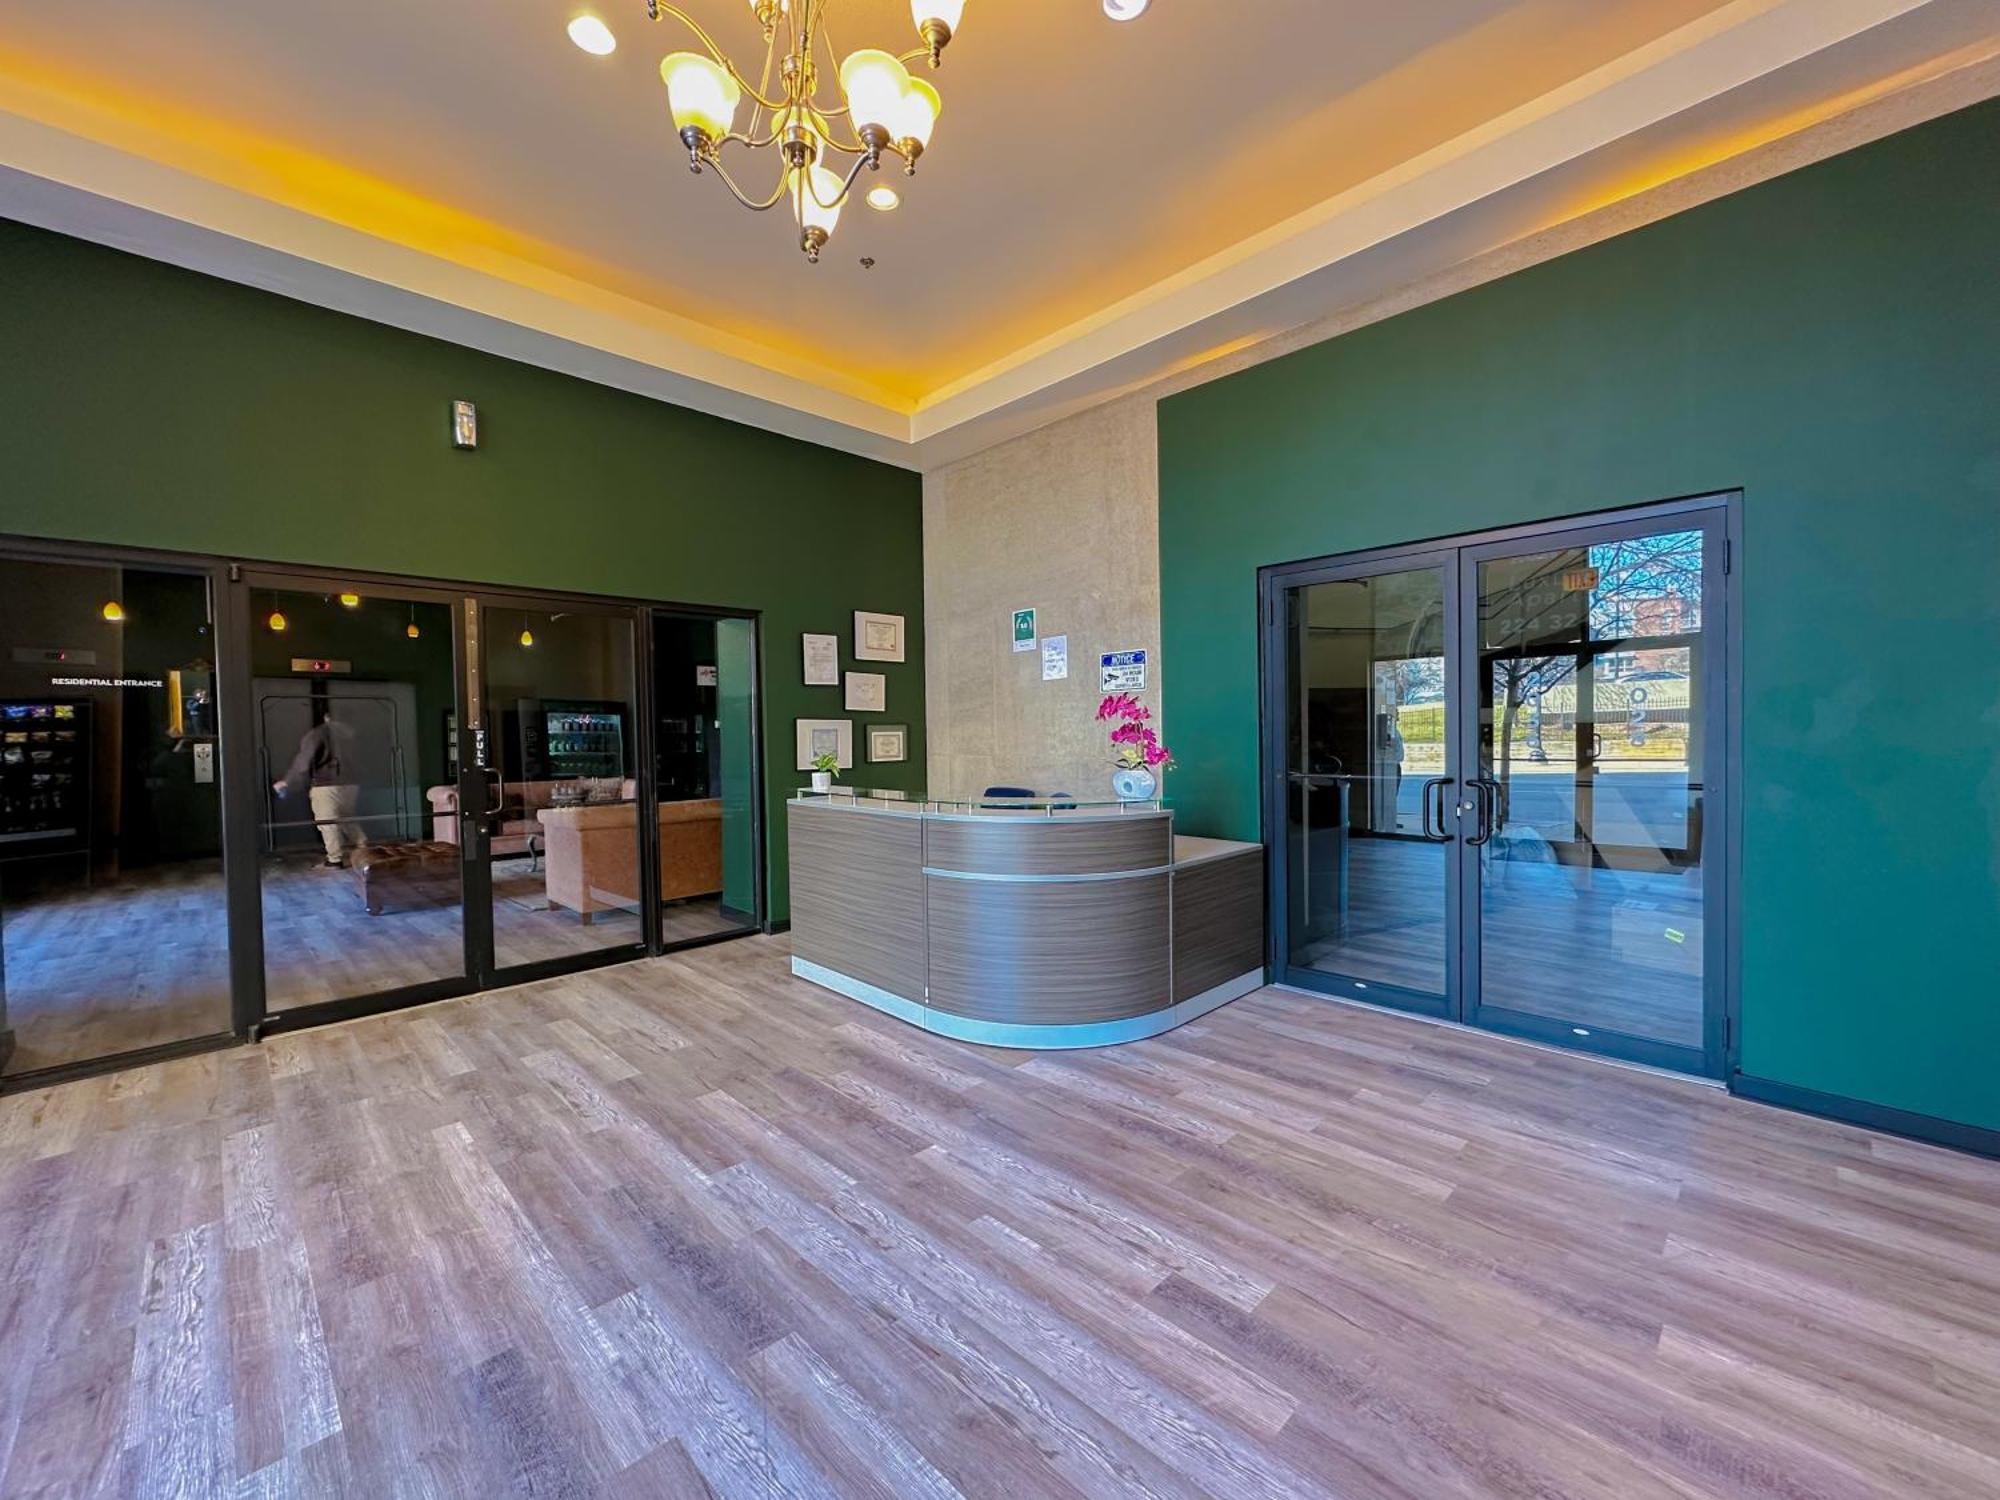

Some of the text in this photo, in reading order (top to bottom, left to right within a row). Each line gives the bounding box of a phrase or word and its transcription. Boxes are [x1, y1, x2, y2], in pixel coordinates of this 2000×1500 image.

[52, 678, 162, 687] RESIDENTIAL ENTRANCE
[476, 734, 484, 766] PULL
